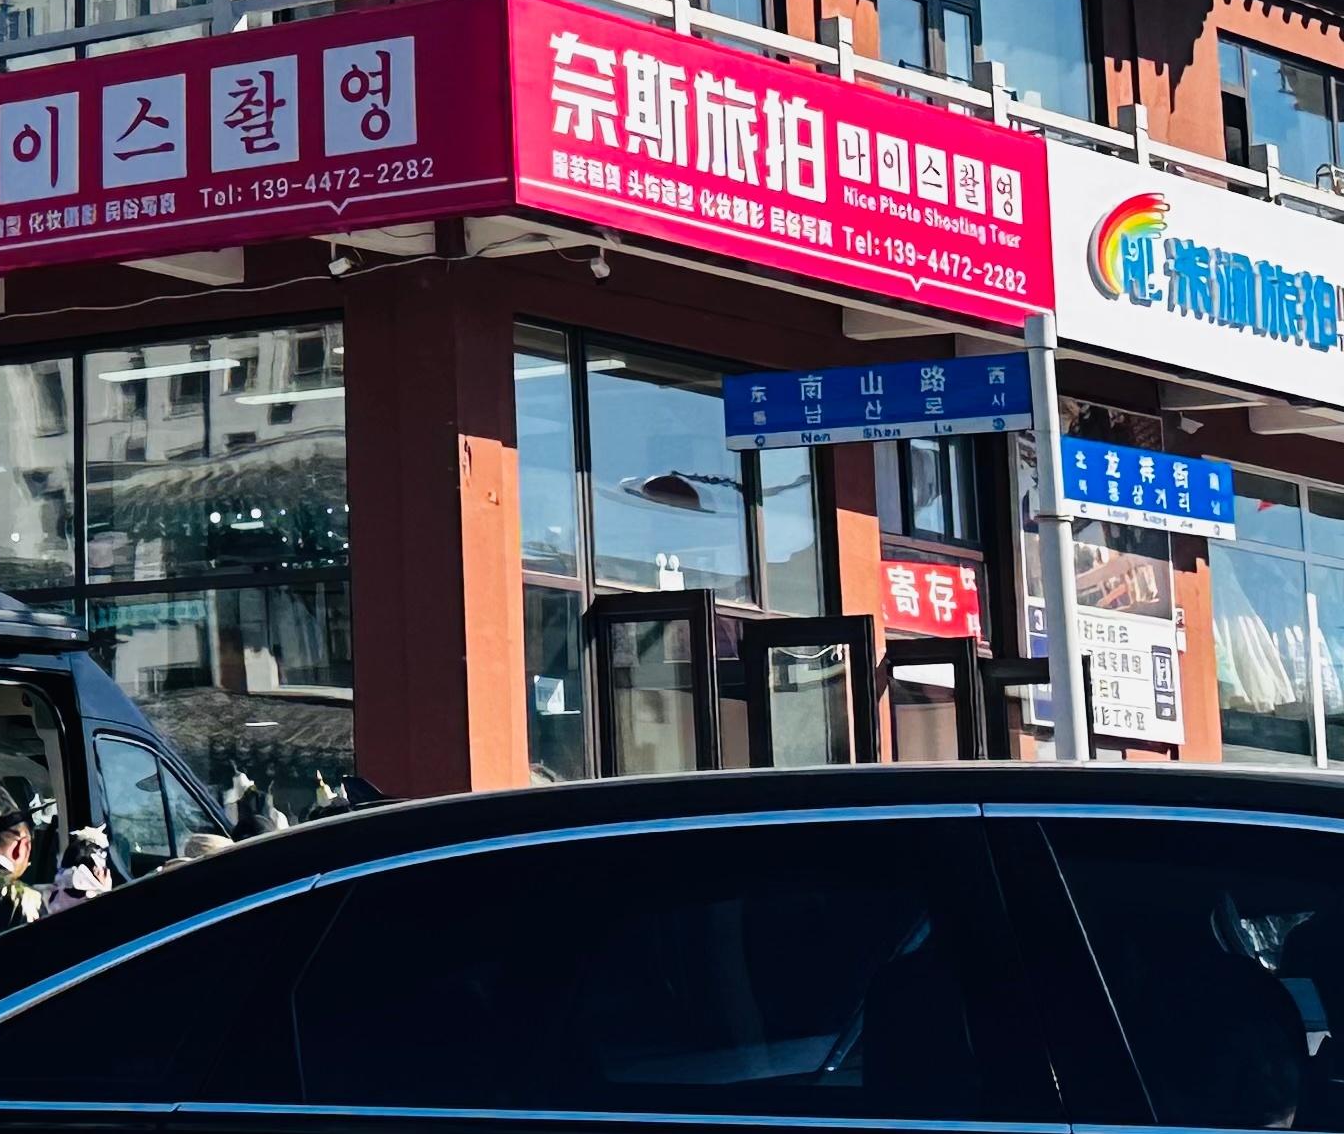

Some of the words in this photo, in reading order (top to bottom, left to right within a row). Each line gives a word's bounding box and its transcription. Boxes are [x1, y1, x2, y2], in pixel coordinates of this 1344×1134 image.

[548, 30, 828, 204] 奈斯旅拍
[250, 157, 436, 203] 139-4472-2282
[842, 130, 1015, 218] 나이스촬영
[843, 185, 876, 211] Nice
[879, 194, 922, 224] Photo
[924, 207, 987, 246] Shooting
[842, 226, 881, 257] Tel:
[883, 236, 1028, 295] 139-4472-2282
[798, 365, 946, 401] 南山路
[986, 366, 1006, 385] 西
[804, 397, 945, 425] 남산로
[800, 431, 831, 444] Nan
[886, 564, 958, 623] 寄存
